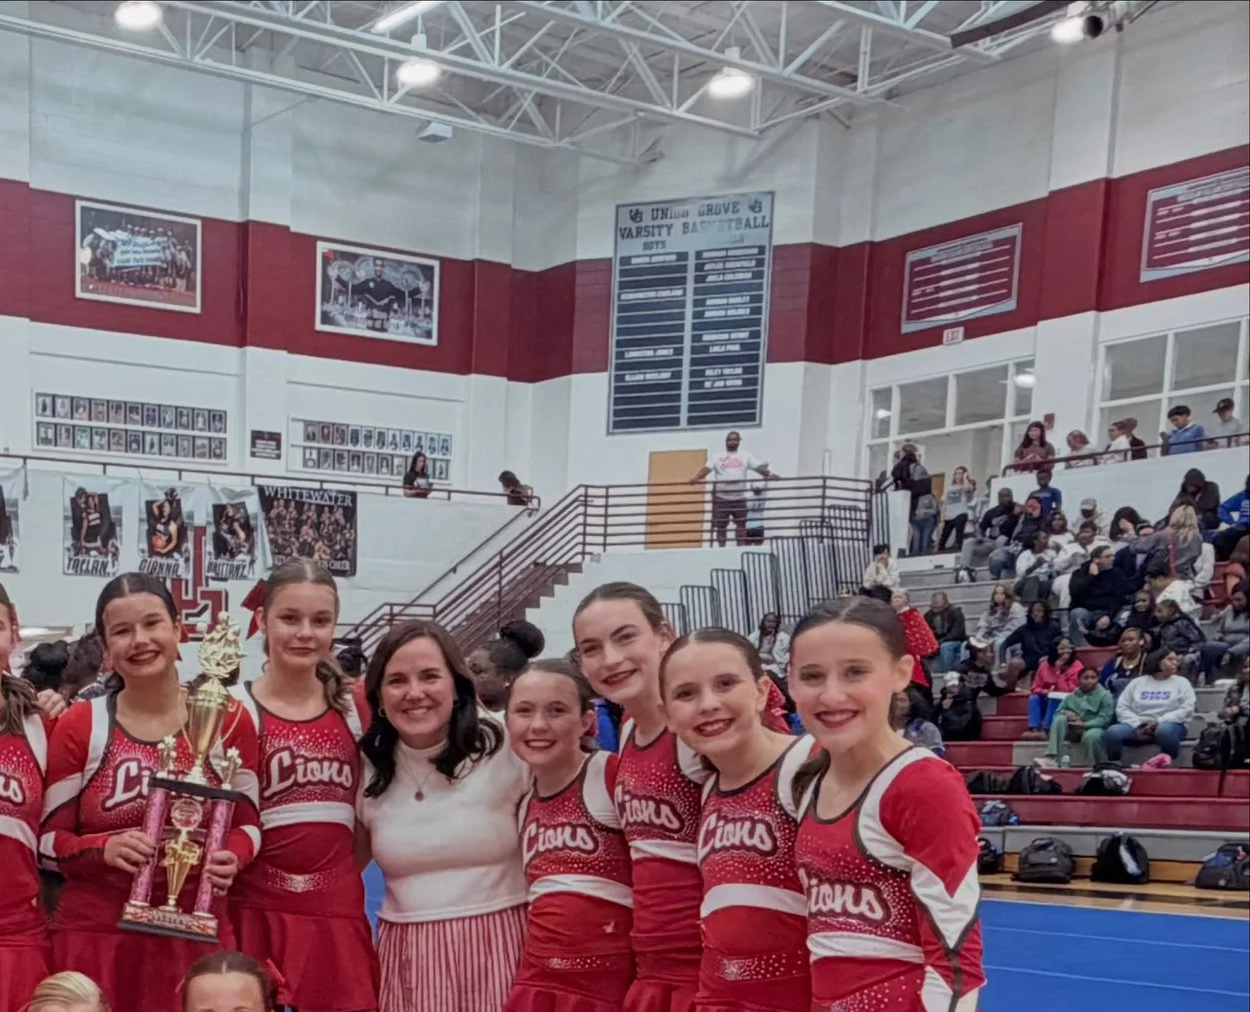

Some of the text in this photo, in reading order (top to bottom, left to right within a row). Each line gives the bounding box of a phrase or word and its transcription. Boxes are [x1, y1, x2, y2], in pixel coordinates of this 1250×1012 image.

[698, 201, 741, 217] GROVE
[619, 215, 770, 241] VARSITY BATBALL
[264, 485, 353, 507] WHITEWATER
[263, 749, 353, 798] Lions
[523, 821, 598, 873] Lions
[698, 812, 773, 868] Lions
